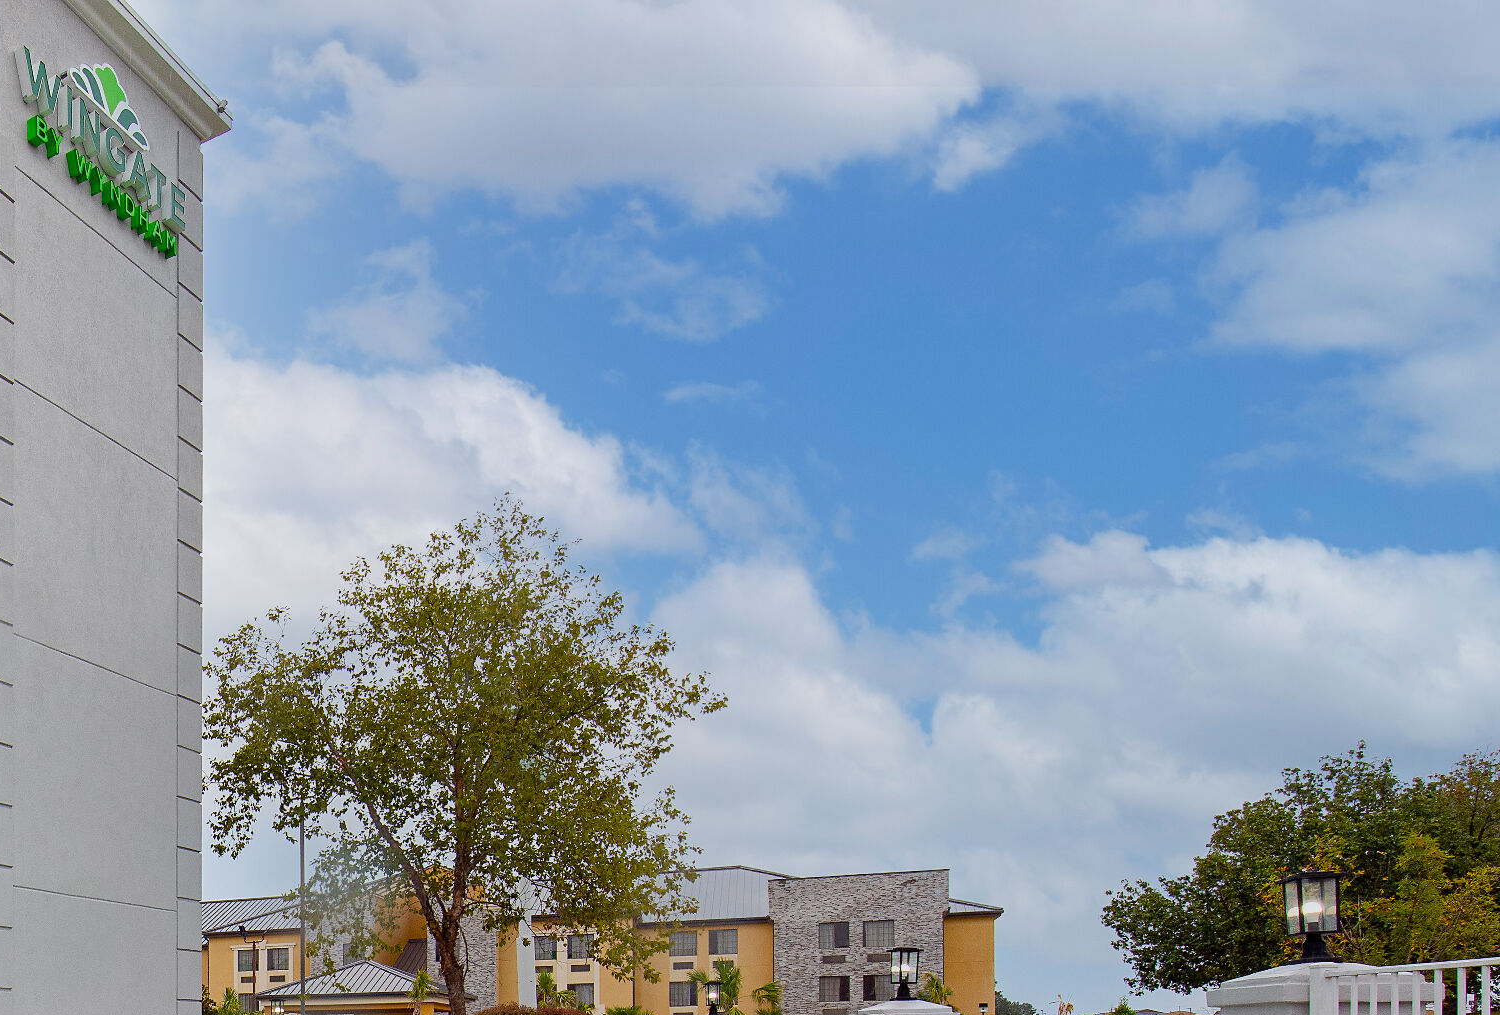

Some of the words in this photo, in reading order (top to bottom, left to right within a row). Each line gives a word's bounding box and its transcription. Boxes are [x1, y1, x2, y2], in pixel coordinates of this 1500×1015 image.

[14, 45, 186, 234] WINGATE
[27, 114, 63, 158] BY
[66, 148, 177, 259] WYNDHAM
